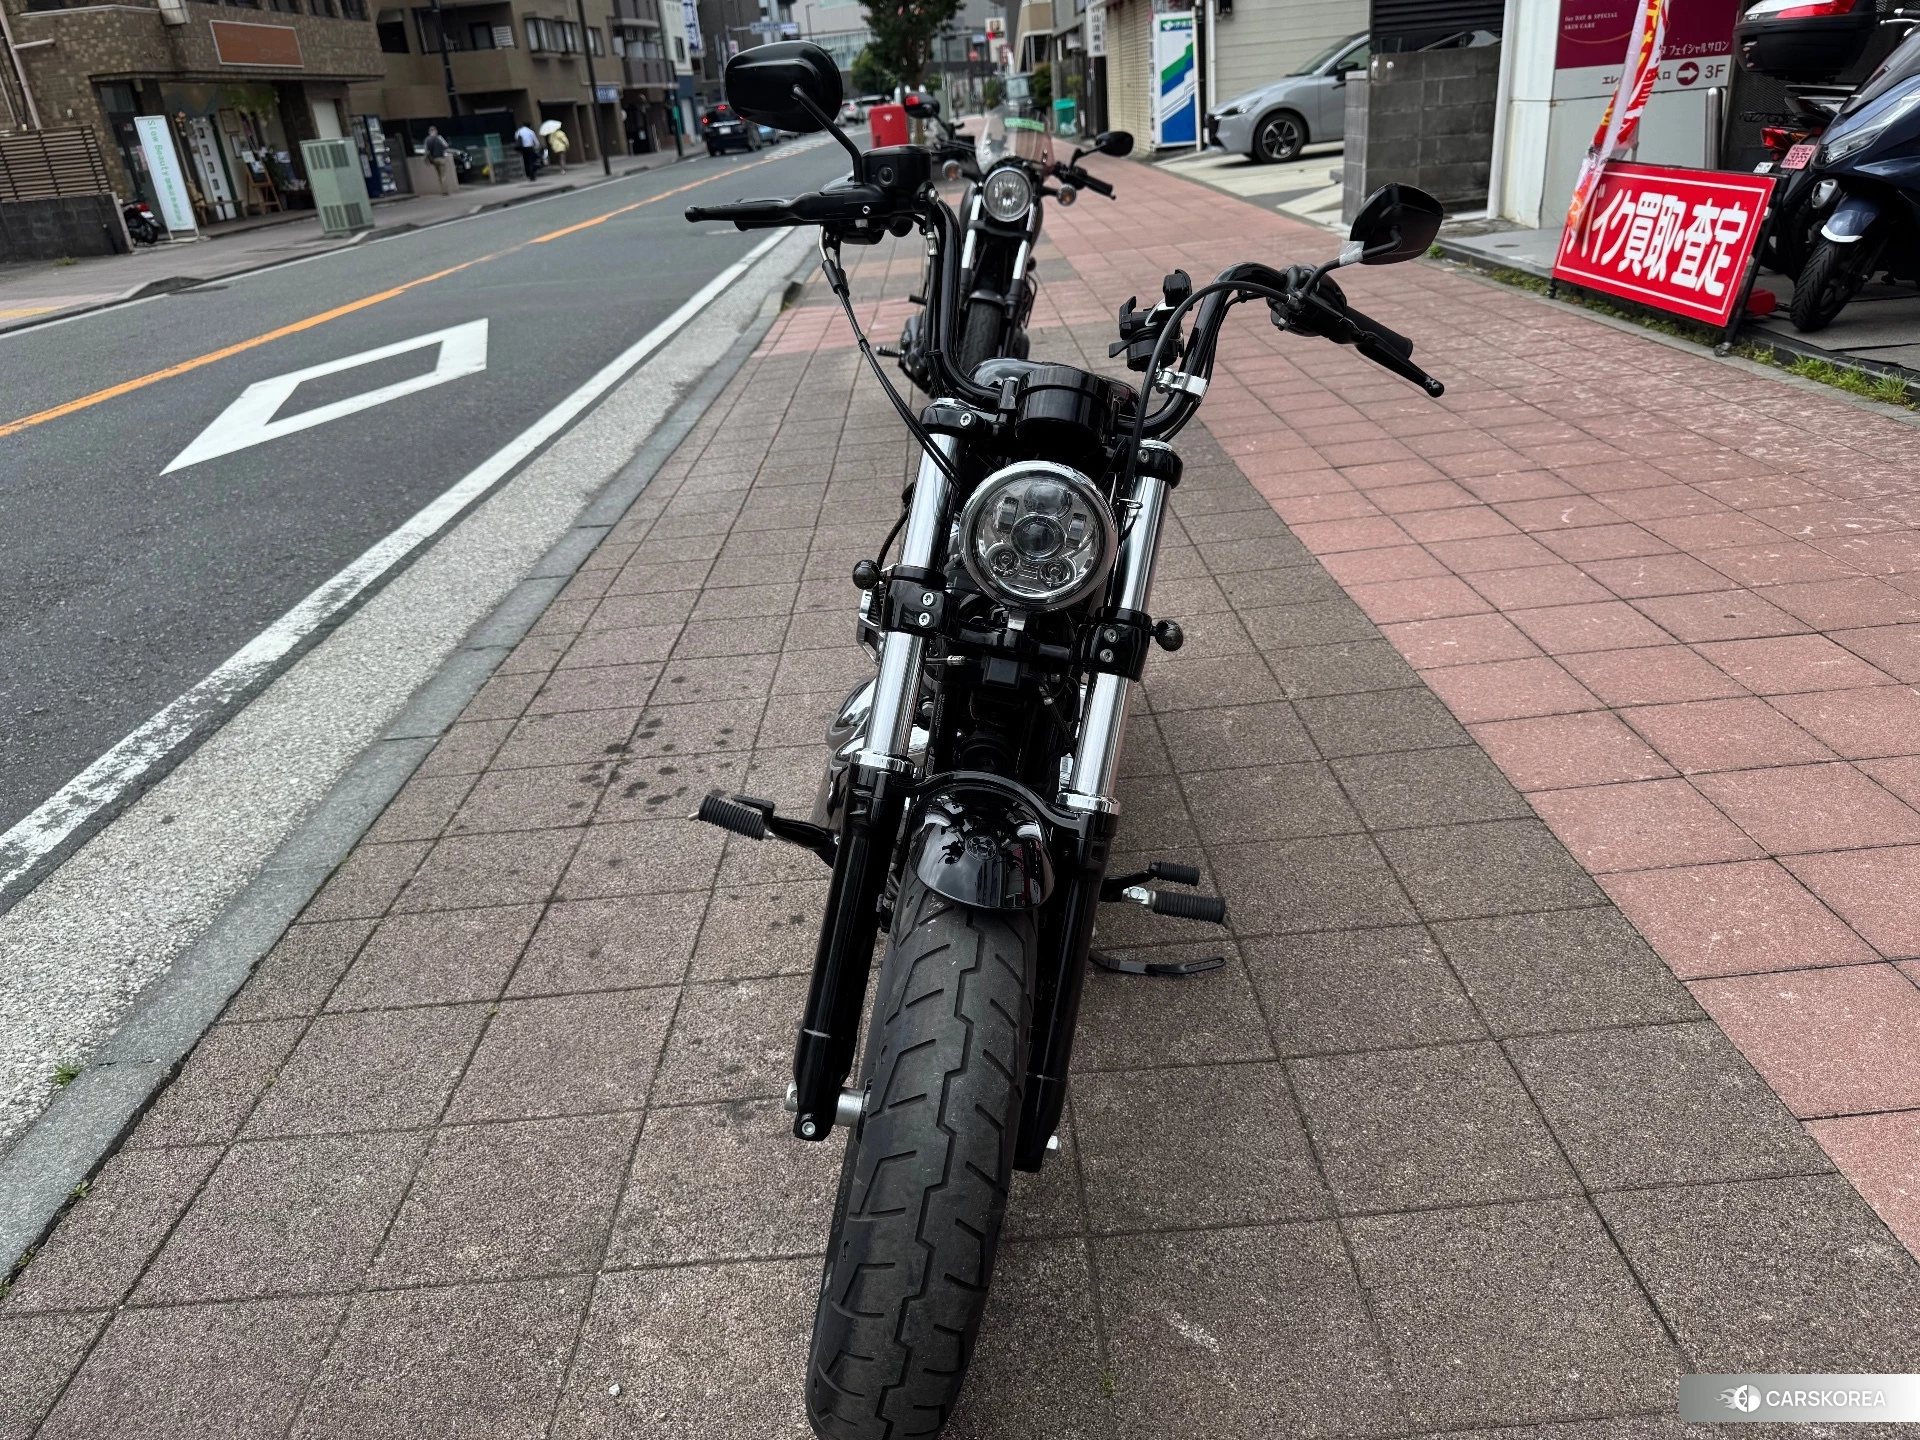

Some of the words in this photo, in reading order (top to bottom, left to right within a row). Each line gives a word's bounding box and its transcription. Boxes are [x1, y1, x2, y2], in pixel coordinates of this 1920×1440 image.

[1594, 12, 1618, 20] SPECIAL
[1669, 41, 1730, 56] フェイシャルサロン
[1705, 64, 1726, 79] 3F
[147, 119, 159, 142] Slow
[154, 145, 170, 176] Beauty
